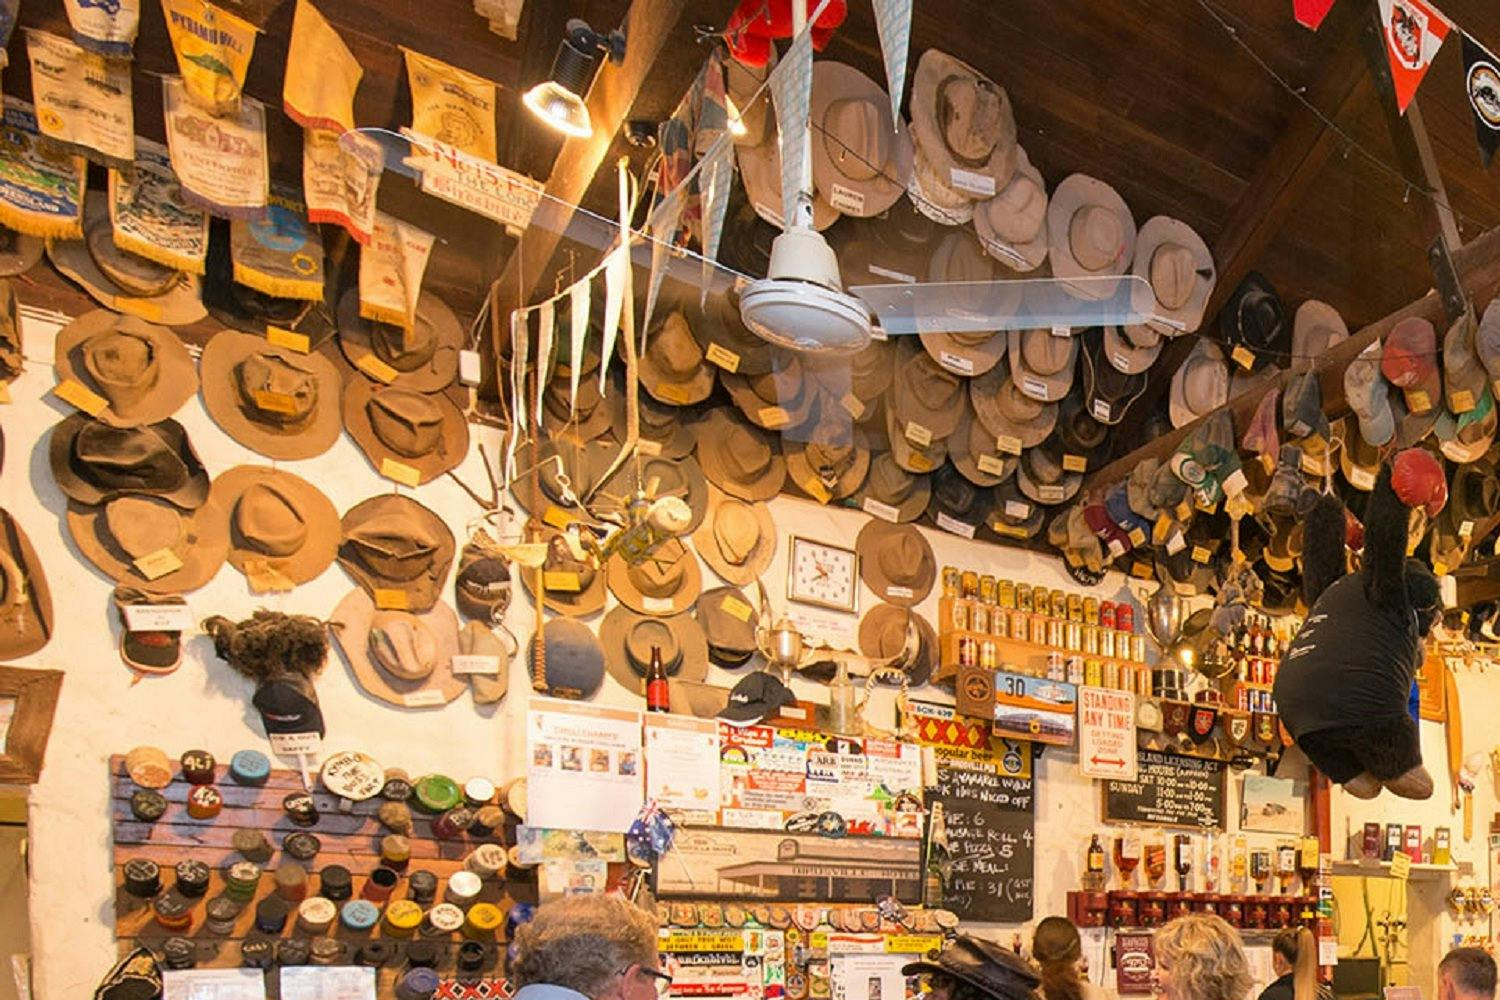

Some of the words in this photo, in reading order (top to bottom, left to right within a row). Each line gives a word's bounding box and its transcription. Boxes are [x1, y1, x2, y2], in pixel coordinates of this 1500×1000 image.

[1005, 677, 1026, 698] 30
[1084, 692, 1131, 712] STANDING
[1084, 710, 1103, 728] ANY
[1108, 713, 1131, 731] TIME
[1109, 781, 1145, 795] SUNDAY
[973, 811, 985, 826] 6
[1022, 829, 1034, 848] 4
